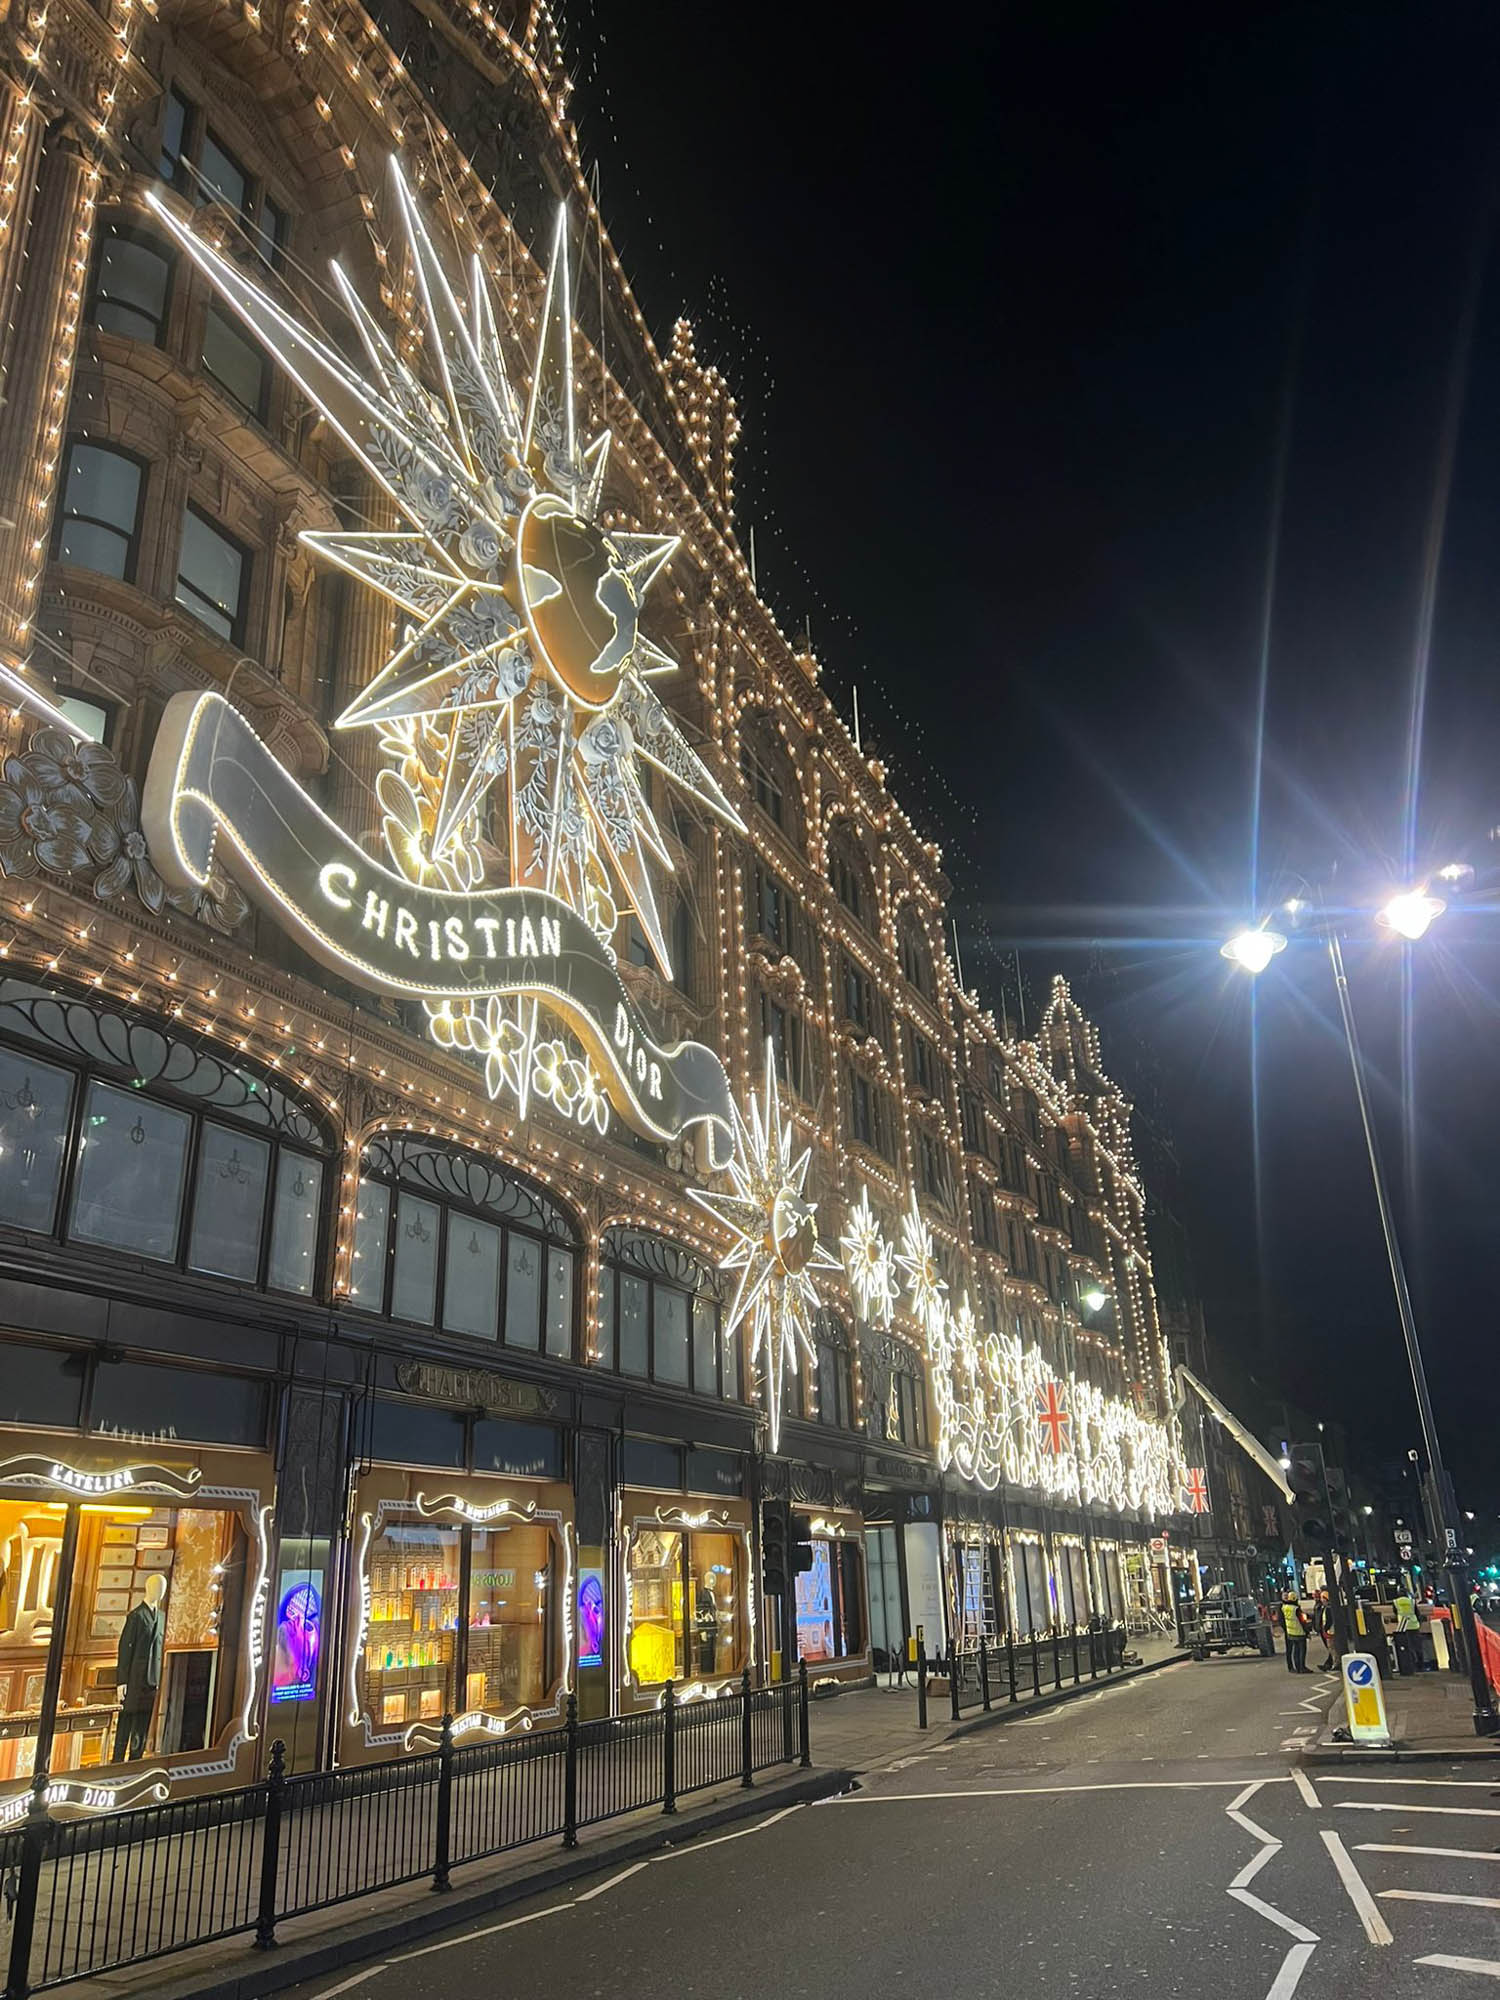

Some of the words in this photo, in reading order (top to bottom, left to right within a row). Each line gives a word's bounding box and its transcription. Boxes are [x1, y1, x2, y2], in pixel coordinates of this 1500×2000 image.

[318, 862, 562, 961] CHRISTIAN
[614, 1002, 664, 1100] DIOR
[50, 1463, 135, 1491] L'ATELIER
[82, 1787, 116, 1807] DIOR
